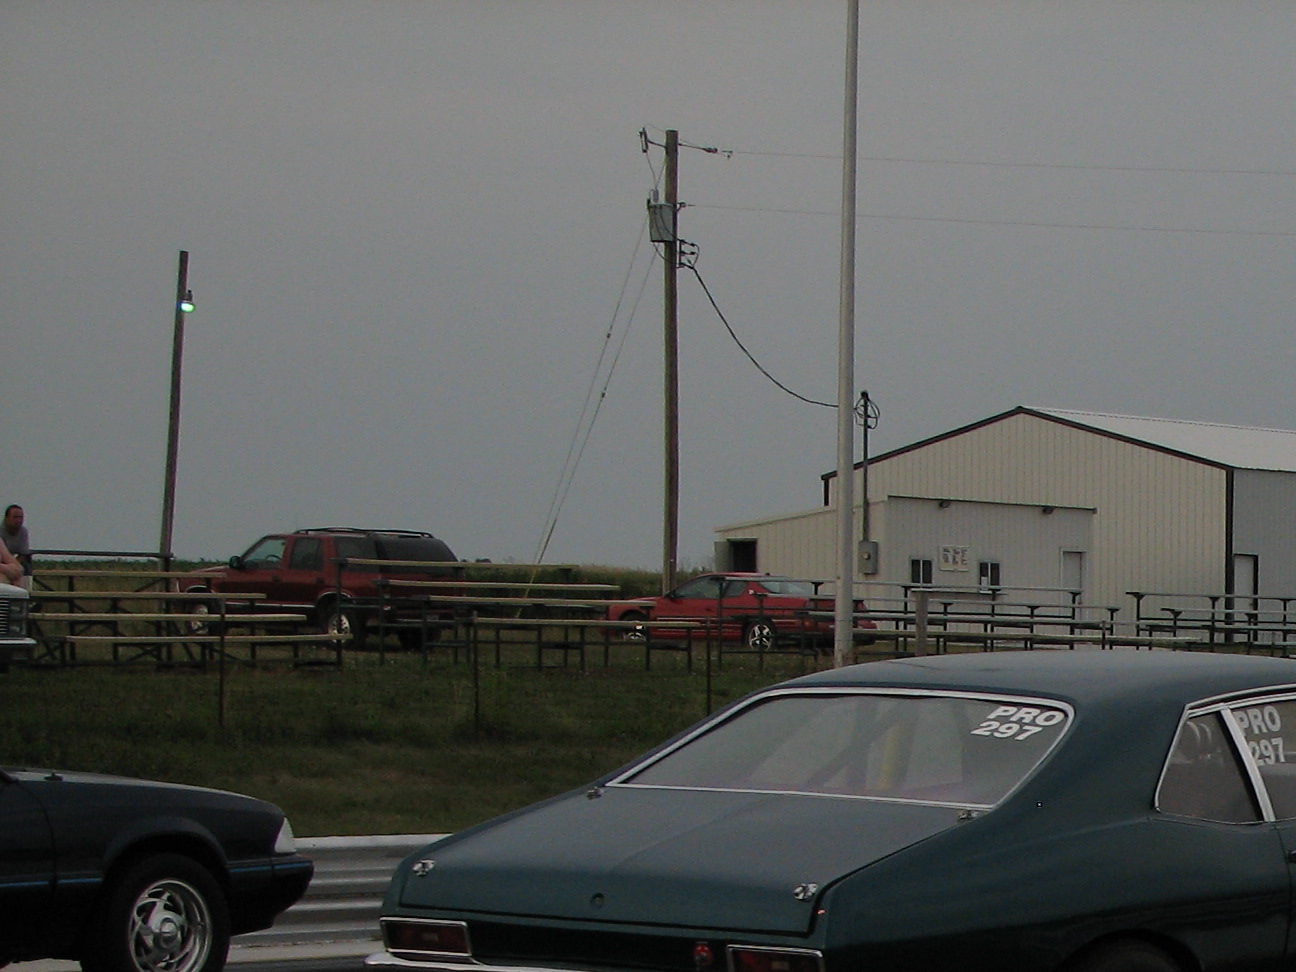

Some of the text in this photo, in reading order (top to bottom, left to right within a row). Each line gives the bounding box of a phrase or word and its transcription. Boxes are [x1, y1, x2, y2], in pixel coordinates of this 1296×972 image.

[986, 706, 1065, 726] PRO
[1232, 705, 1281, 737] PRO
[970, 721, 1043, 740] 297
[1248, 737, 1285, 766] 297
